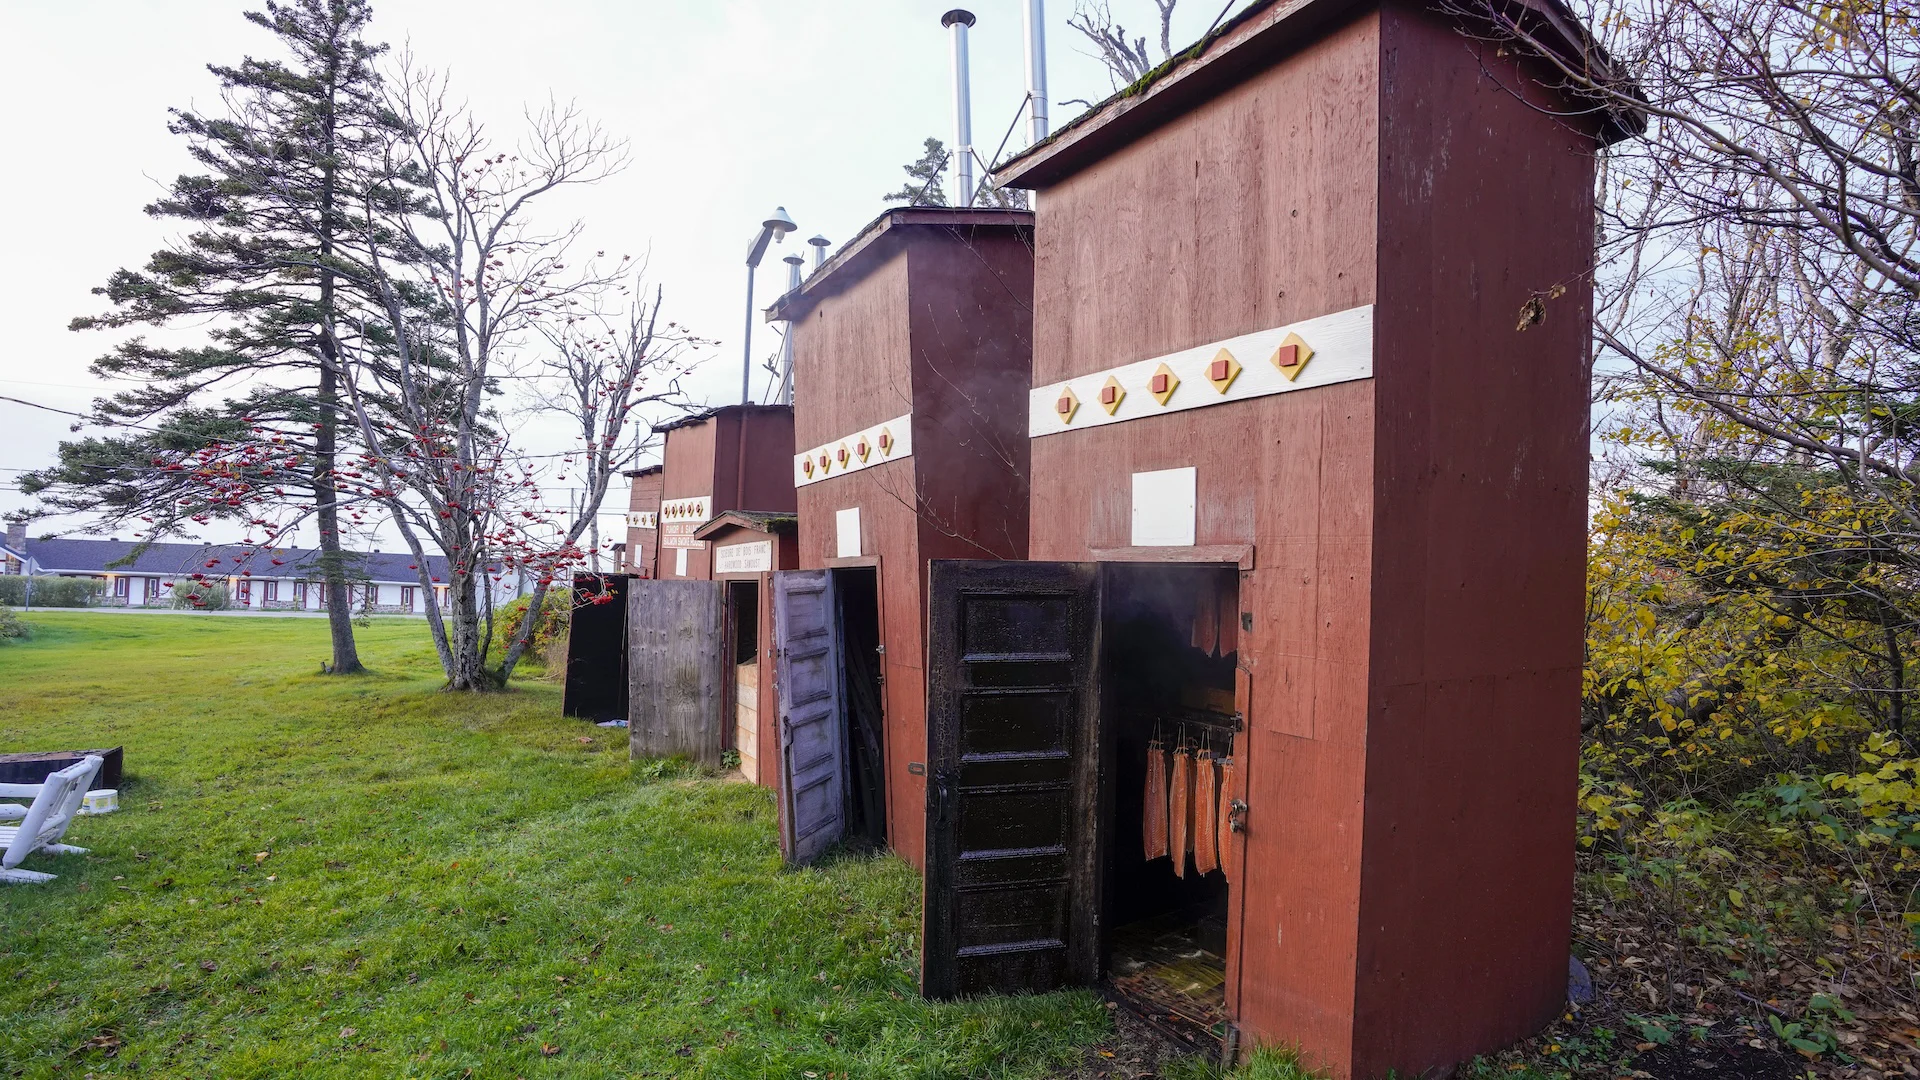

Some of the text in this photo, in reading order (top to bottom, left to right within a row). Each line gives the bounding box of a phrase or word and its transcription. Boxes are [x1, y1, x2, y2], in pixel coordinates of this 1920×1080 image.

[664, 537, 677, 545] SALMON
[736, 547, 740, 556] DE
[743, 546, 751, 555] BOIS
[754, 545, 766, 554] FRANC
[725, 559, 760, 569] HARDWOOD SAWDUST
